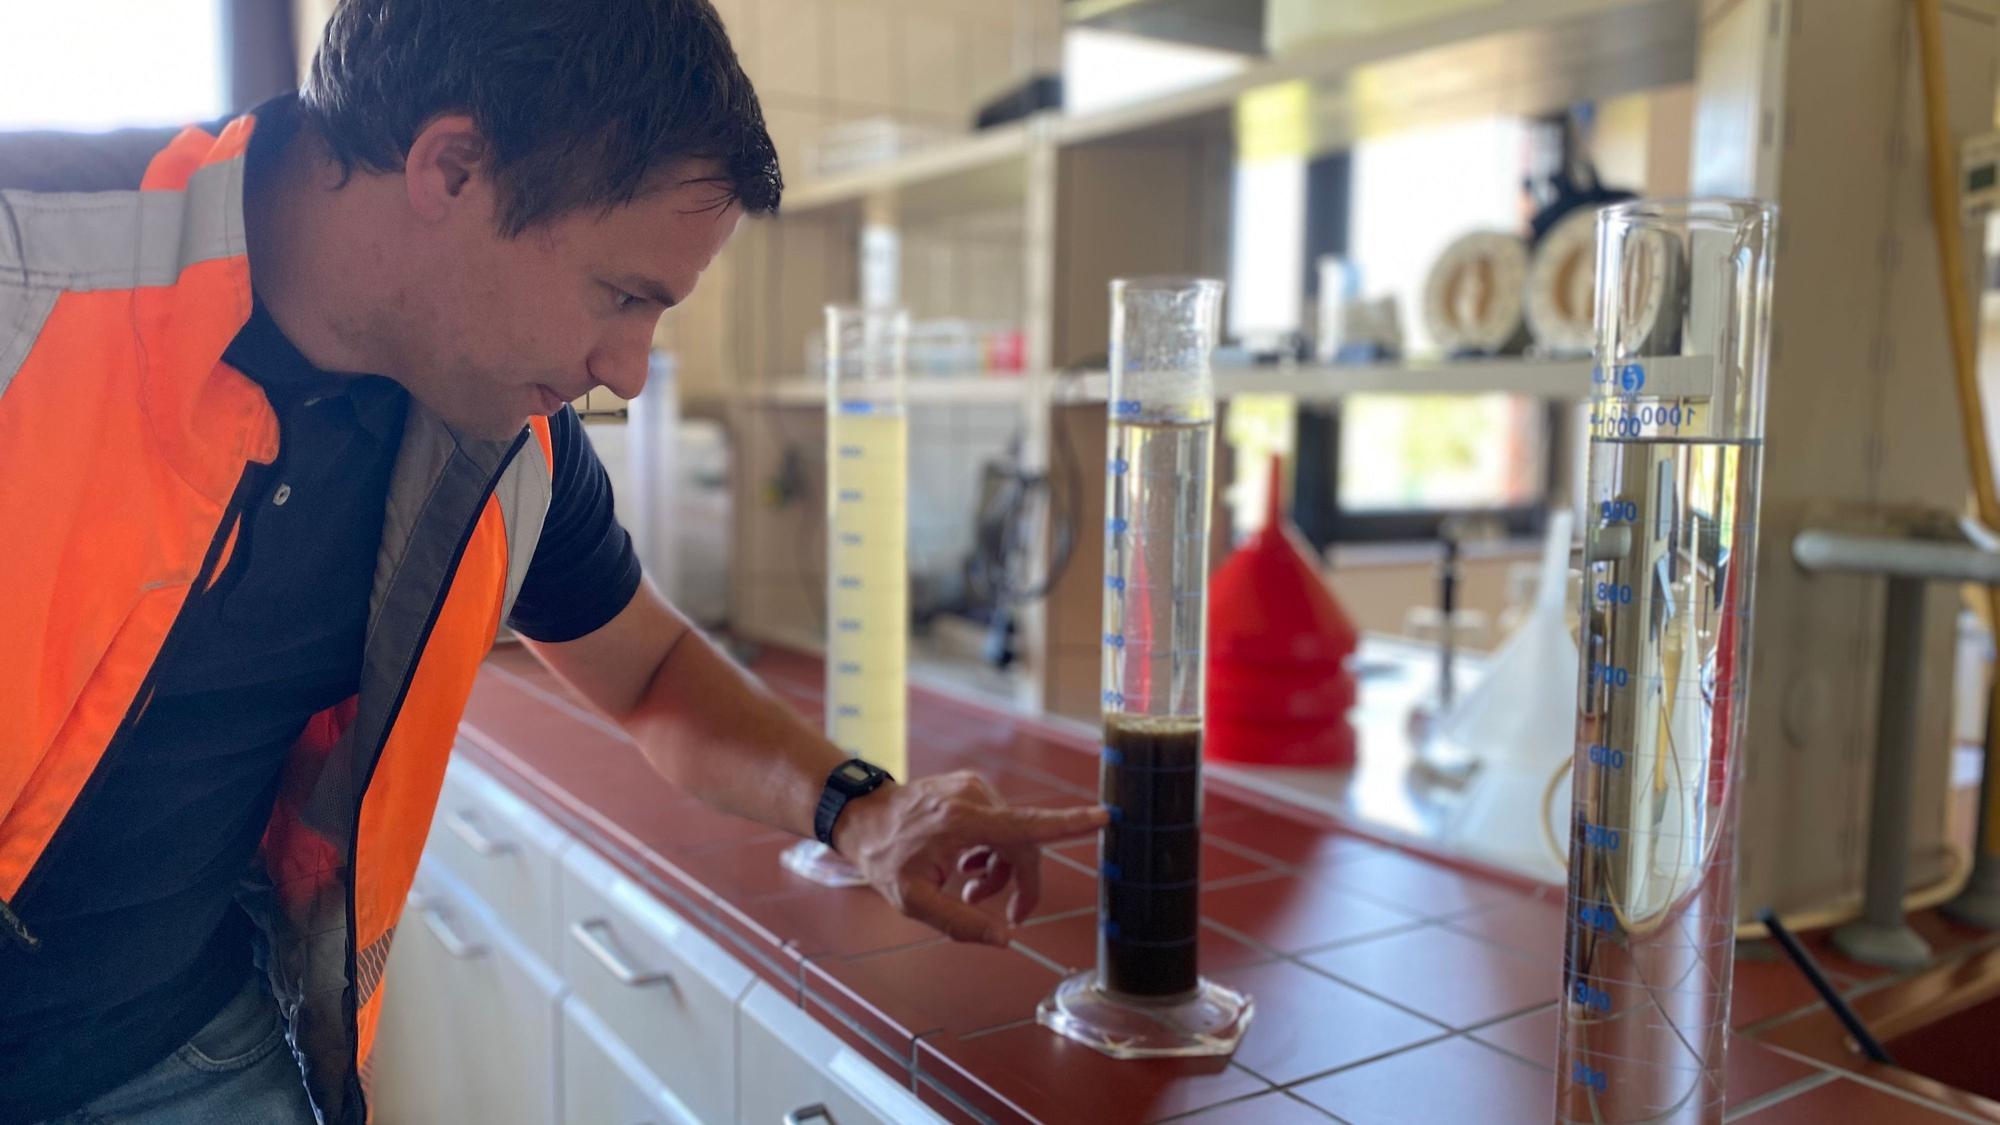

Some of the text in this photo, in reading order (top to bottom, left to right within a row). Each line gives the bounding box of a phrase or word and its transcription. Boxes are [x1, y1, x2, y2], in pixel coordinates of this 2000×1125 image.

[1597, 581, 1633, 604] 800
[1591, 660, 1628, 688] 700
[1589, 745, 1624, 770] 600
[1584, 823, 1620, 850] 500
[1577, 981, 1613, 1012] 300
